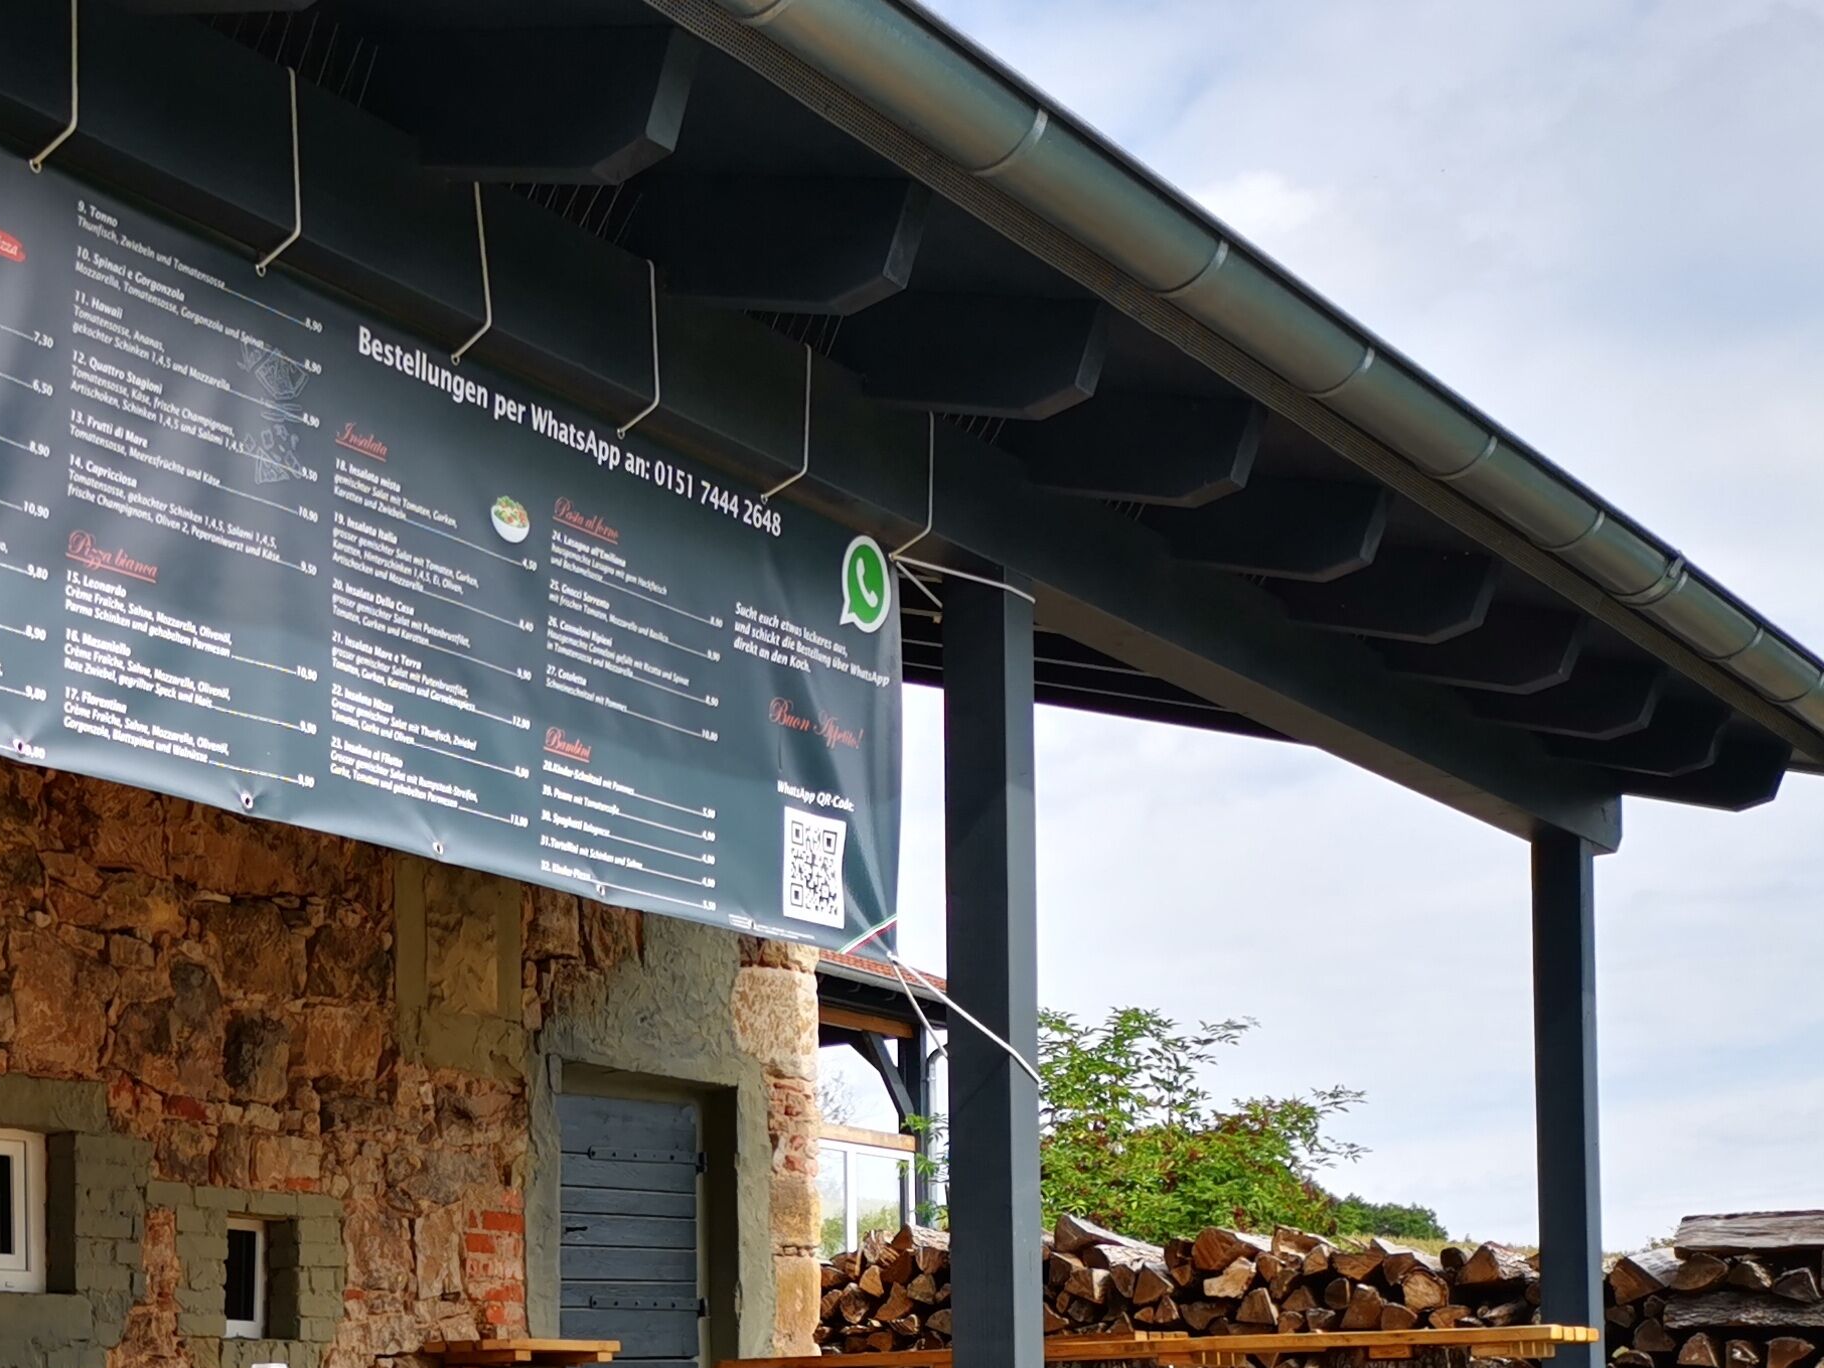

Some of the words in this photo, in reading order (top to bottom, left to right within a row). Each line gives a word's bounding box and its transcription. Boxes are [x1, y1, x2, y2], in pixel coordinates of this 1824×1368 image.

[78, 200, 86, 214] 9.
[90, 205, 118, 227] Tonno
[77, 246, 90, 261] 10.
[93, 253, 126, 276] Spinaci
[127, 271, 133, 279] e
[135, 272, 184, 301] Gorgonzola
[78, 215, 118, 244] Thunfisch,
[120, 235, 155, 258] Zwiebeln
[156, 254, 172, 266] und
[174, 258, 225, 289] Tomatensosse
[305, 318, 322, 333] 8,90
[75, 290, 89, 306] 11.
[91, 298, 122, 318] Hawaii
[75, 261, 120, 290] Mozzarella,
[124, 281, 178, 314] Tomatensosse,
[181, 306, 223, 332] Gorgonzola
[224, 327, 240, 339] und
[304, 359, 322, 374] 8,90
[34, 331, 54, 348] 7,30
[74, 305, 131, 338] Tomatensosse,
[133, 331, 164, 352] Ananas,
[32, 379, 53, 396] 6,50
[72, 322, 112, 343] gekochter
[114, 337, 149, 359] Schinken
[152, 352, 171, 368] 1,4,5
[172, 363, 188, 375] und
[189, 367, 230, 391] Mozzarella
[302, 413, 319, 427] 8,90
[73, 350, 86, 365] 12.
[89, 357, 125, 379] Quattro
[127, 371, 162, 394] Stagioni
[72, 365, 129, 397] Tomatensosse,
[131, 388, 151, 406] Käse,
[154, 397, 180, 416] frische
[181, 408, 234, 436] Champignons,
[71, 409, 84, 424] 13.
[87, 416, 113, 434] Frutti
[114, 427, 124, 438] di
[125, 430, 147, 448] Mare
[337, 422, 387, 456] Insalata
[358, 325, 488, 408] Bestellungen
[494, 394, 526, 424] per
[531, 403, 620, 469] WhatsApp
[625, 450, 650, 480] an:
[654, 460, 693, 499] 0151
[701, 480, 738, 518] 7444
[744, 500, 782, 537] 2648
[29, 441, 50, 457] 8,90
[70, 454, 83, 469] 14.
[86, 460, 137, 487] Capricciosa
[24, 501, 49, 518] 10,90
[27, 564, 48, 580] 9,80
[67, 570, 80, 584] 15.
[83, 576, 126, 597] Leonardo
[25, 625, 46, 640] 8,90
[735, 602, 757, 621] Sucht
[758, 614, 779, 628] euch
[781, 621, 802, 637] etwas
[803, 628, 832, 649] leckeres
[833, 643, 848, 657] aus,
[734, 622, 750, 635] und
[752, 628, 780, 645] schickt
[782, 636, 795, 650] die
[796, 641, 831, 667] Bestellung
[832, 657, 849, 672] über
[850, 664, 890, 687] WhatsApp
[734, 637, 758, 655] direkt
[759, 648, 770, 659] an
[771, 650, 788, 665] den
[790, 655, 810, 672] Koch.
[768, 696, 810, 731] Buon
[777, 779, 816, 804] WhatsApp
